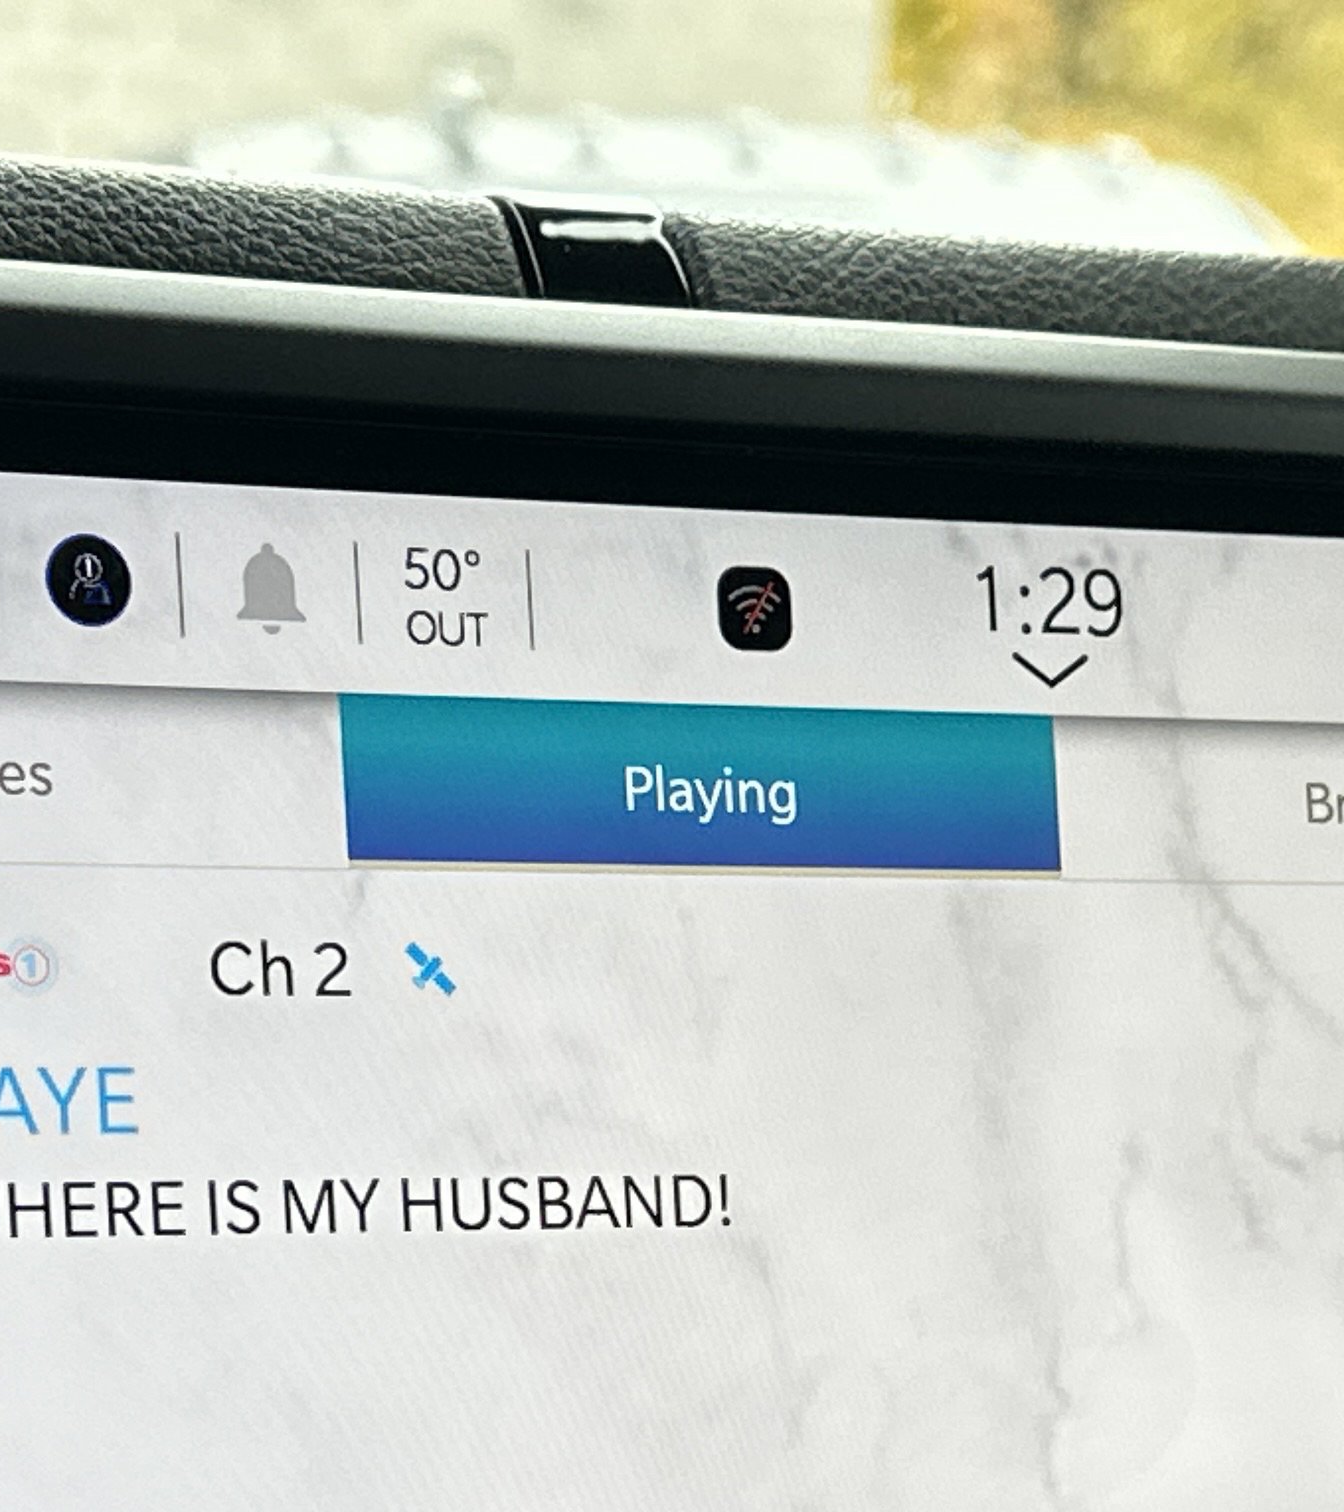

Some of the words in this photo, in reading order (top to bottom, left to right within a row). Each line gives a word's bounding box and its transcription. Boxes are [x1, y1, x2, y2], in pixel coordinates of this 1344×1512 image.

[404, 547, 480, 592] 50°
[406, 610, 489, 647] OUT
[976, 565, 1123, 638] 1:29
[625, 764, 797, 825] Playing
[210, 939, 294, 997] Ch
[314, 942, 352, 997] 2
[208, 1179, 260, 1236] IS
[283, 1178, 380, 1234] MY
[401, 1173, 731, 1232] HUSBAND!
